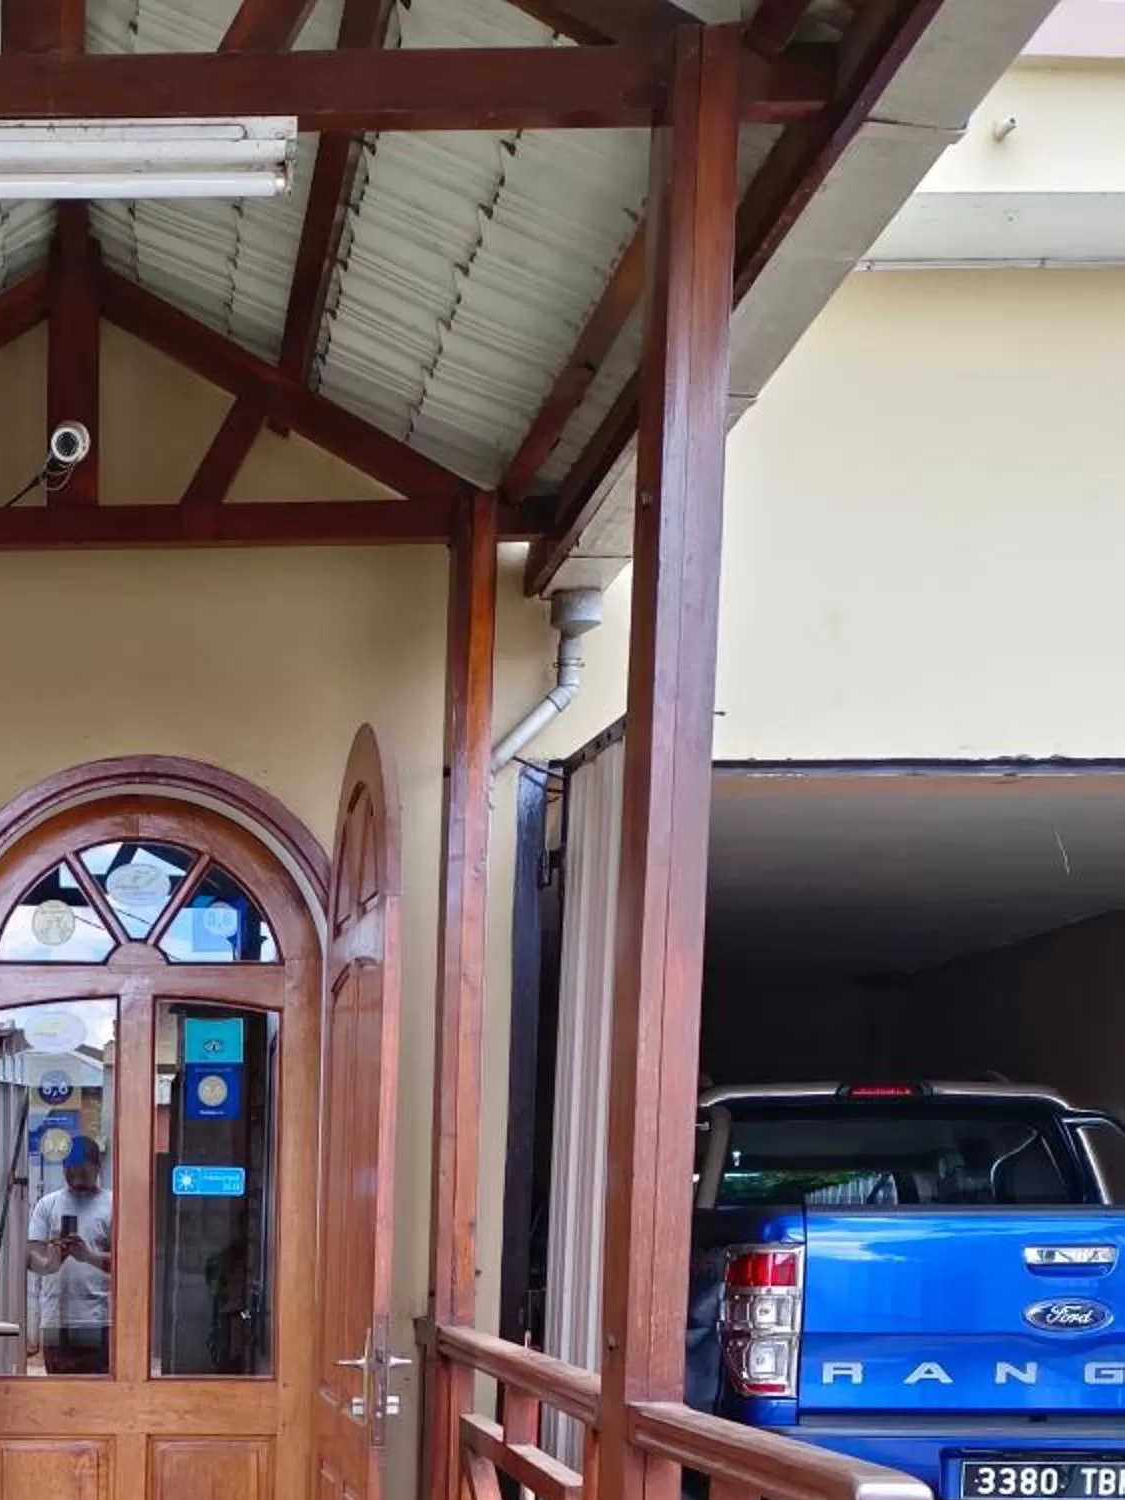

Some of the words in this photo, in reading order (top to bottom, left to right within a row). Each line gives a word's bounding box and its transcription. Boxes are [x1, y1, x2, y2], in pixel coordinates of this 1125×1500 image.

[1046, 1304, 1094, 1324] Ford
[822, 1362, 1125, 1385] RANG
[977, 1467, 1059, 1495] 3380
